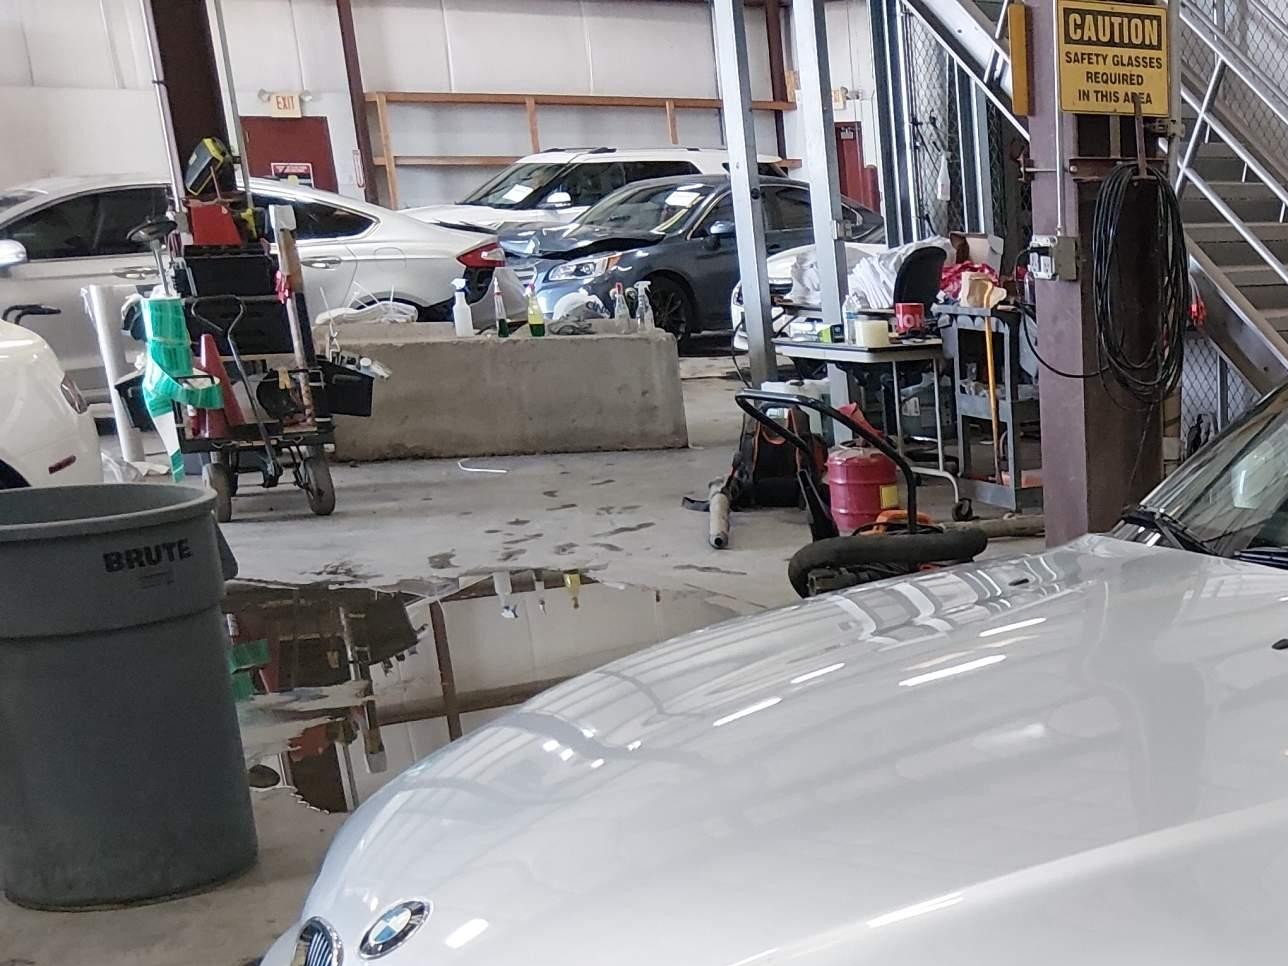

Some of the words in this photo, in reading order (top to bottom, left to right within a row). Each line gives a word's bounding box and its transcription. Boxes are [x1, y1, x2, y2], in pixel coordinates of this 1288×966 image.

[1068, 13, 1158, 46] CAUTION
[1065, 51, 1109, 66] SAFETY
[1112, 54, 1163, 69] GLASSES
[1086, 71, 1144, 86] REQUIRED
[276, 95, 295, 111] EXIT
[1078, 89, 1090, 102] IN
[1093, 90, 1120, 103] THIS
[102, 538, 193, 573] BRUTE
